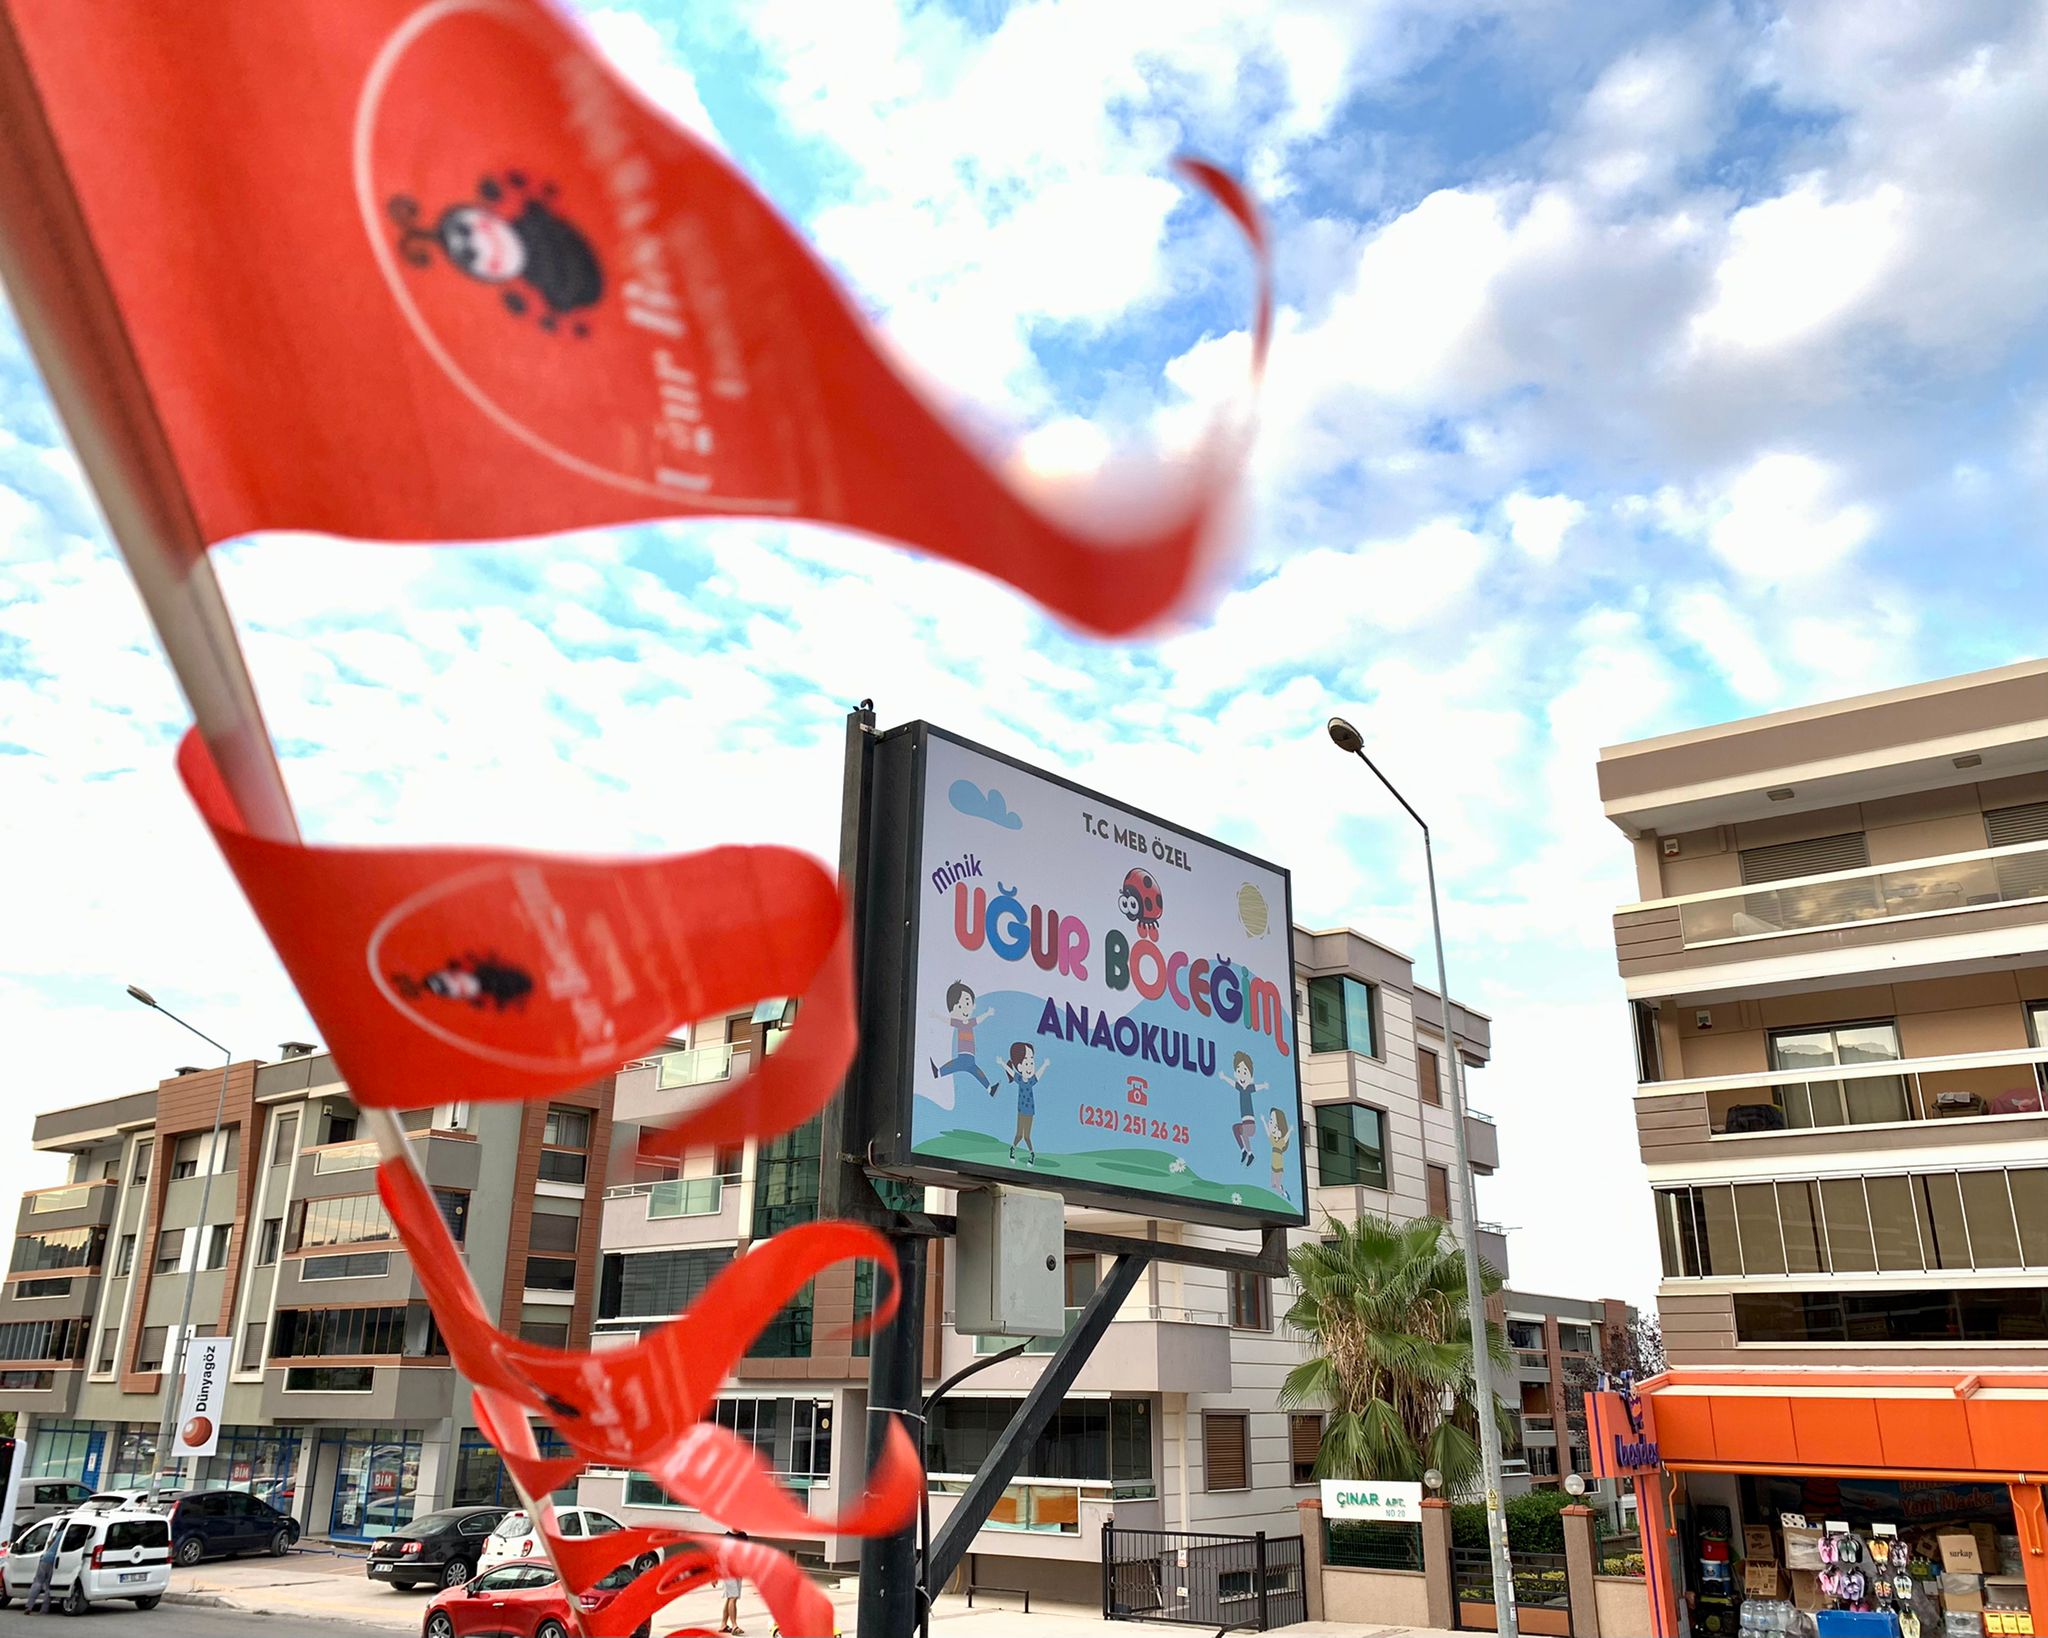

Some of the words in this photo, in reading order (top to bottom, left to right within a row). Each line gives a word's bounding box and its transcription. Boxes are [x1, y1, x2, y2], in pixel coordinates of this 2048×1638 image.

[1082, 812, 1109, 839] T.C
[1113, 824, 1147, 854] MEB
[1152, 836, 1192, 872] ÖZEL
[931, 854, 983, 894] minik
[954, 881, 1090, 981] UĞUR
[1036, 996, 1216, 1077] ANAOKULU
[1079, 1104, 1119, 1131] (232)
[1123, 1114, 1147, 1136] 251
[1151, 1119, 1169, 1140] 26
[1172, 1124, 1190, 1144] 25
[195, 1345, 216, 1412] Dünyagöz
[375, 1470, 392, 1487] BİM
[1336, 1491, 1381, 1508] ÇINAR
